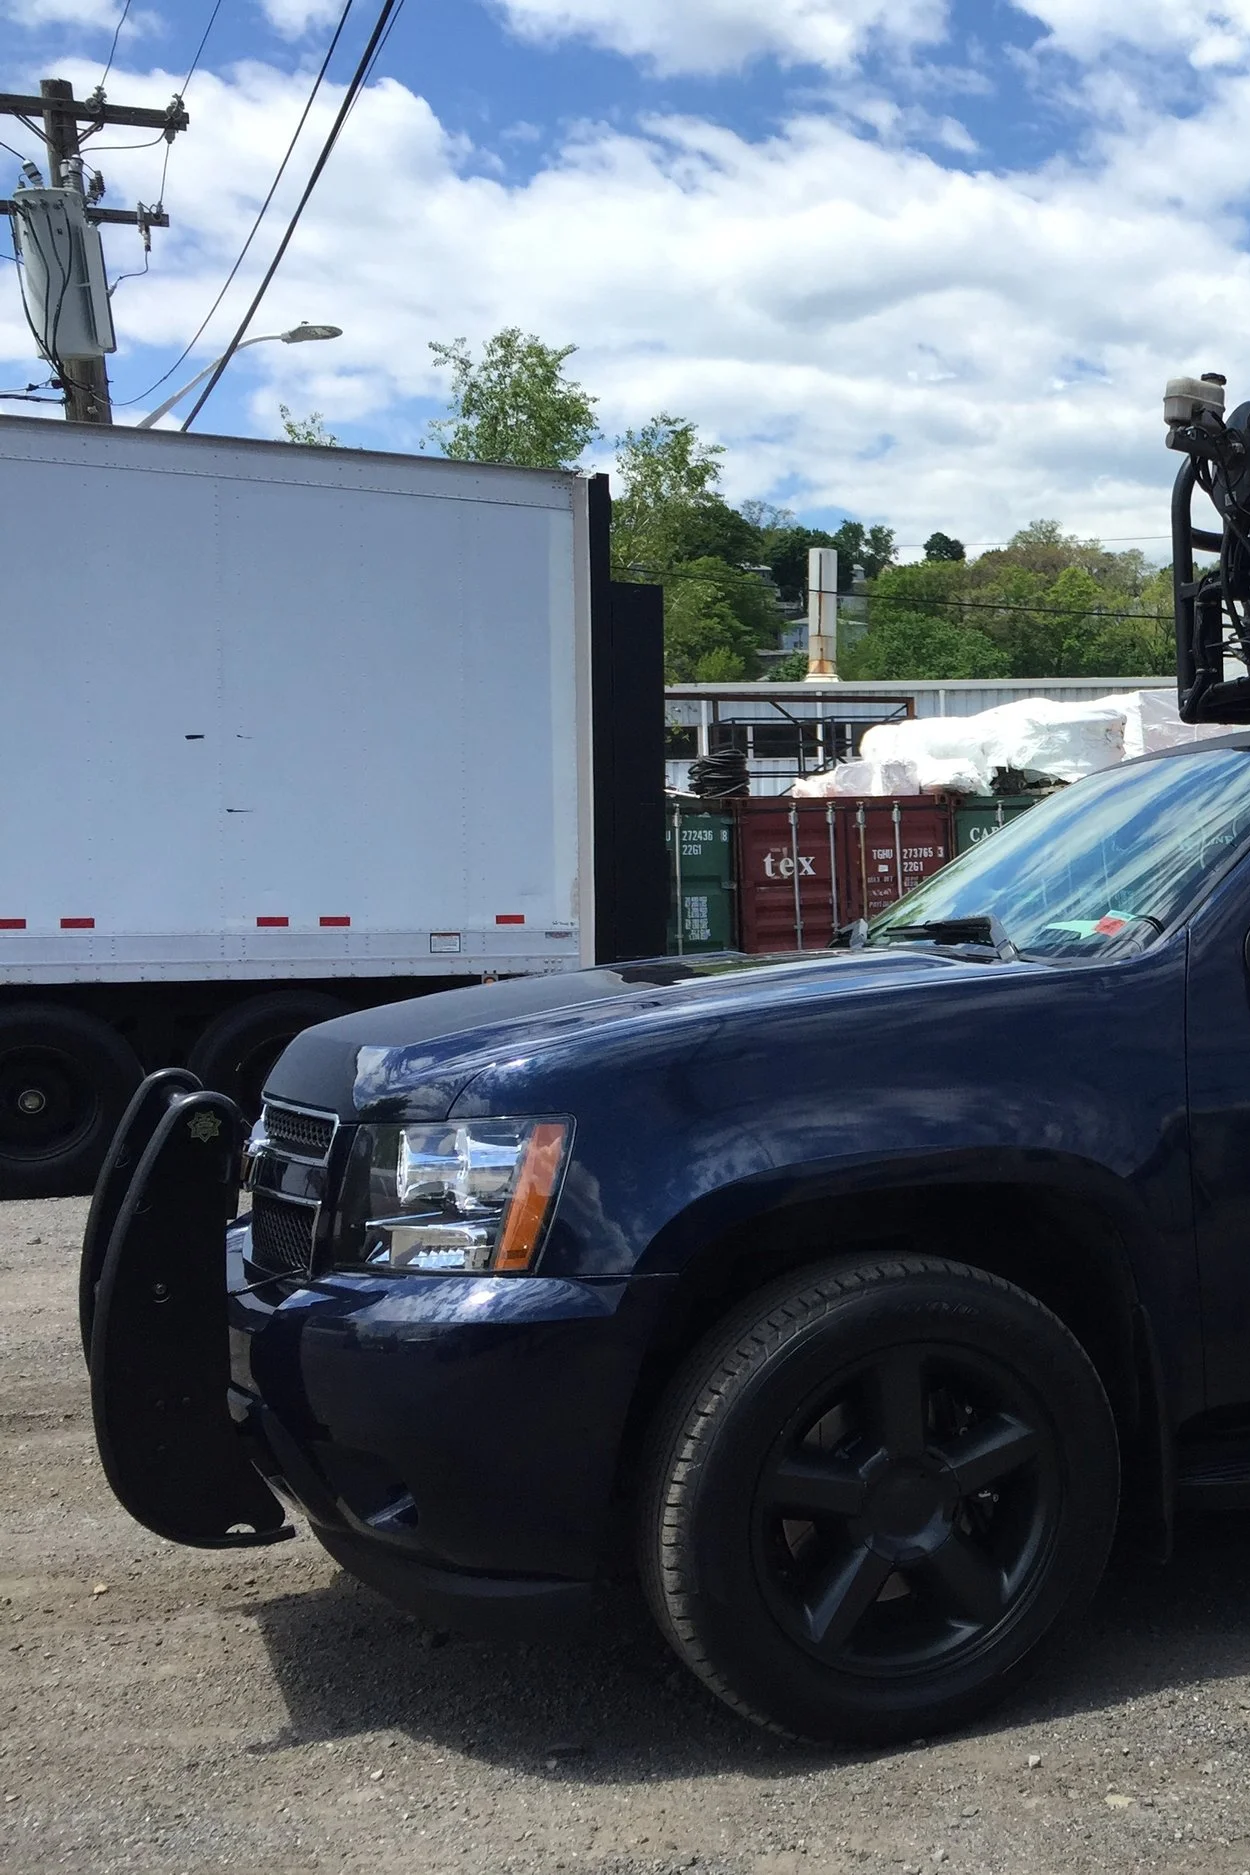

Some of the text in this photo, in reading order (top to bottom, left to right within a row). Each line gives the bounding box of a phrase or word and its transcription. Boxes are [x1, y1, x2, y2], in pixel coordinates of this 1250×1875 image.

[682, 830, 713, 841] 272436
[721, 830, 728, 841] 8
[682, 845, 702, 855] 22G1
[872, 846, 944, 860] TGHU 273765 3
[763, 852, 816, 877] tex
[903, 861, 923, 872] 22G1
